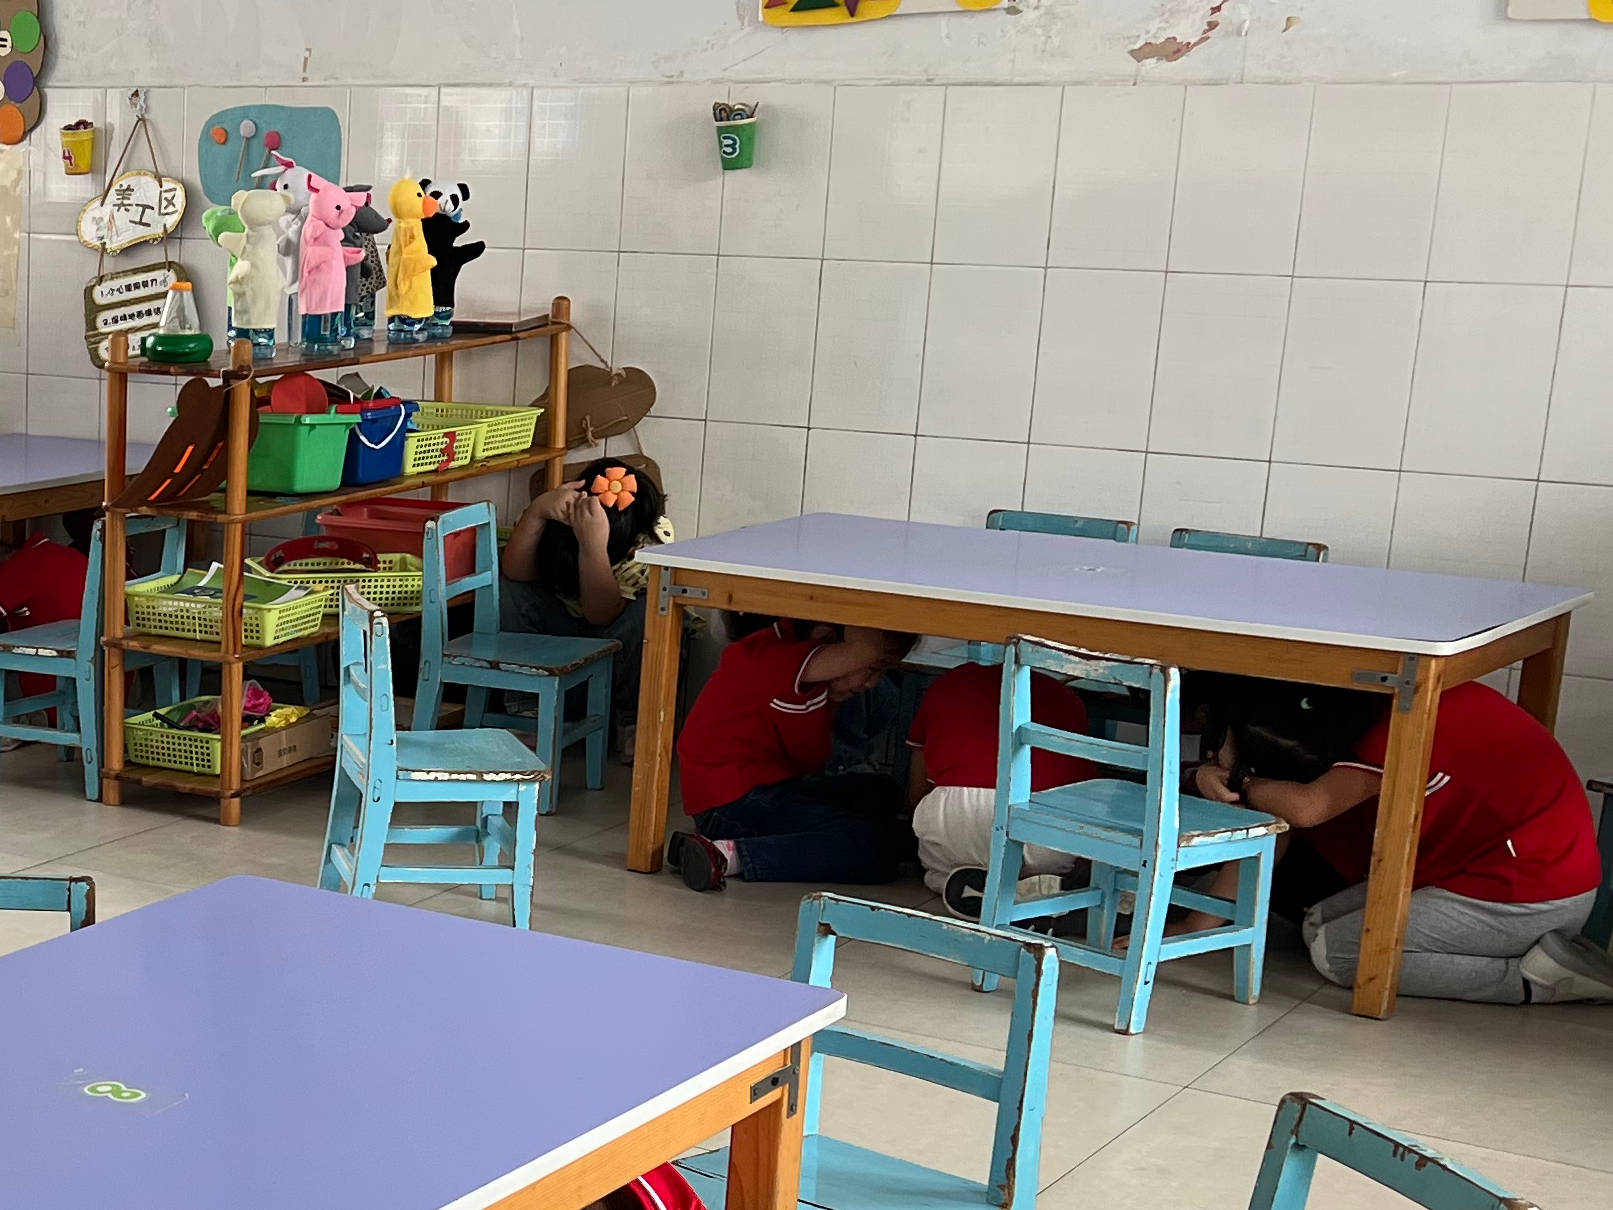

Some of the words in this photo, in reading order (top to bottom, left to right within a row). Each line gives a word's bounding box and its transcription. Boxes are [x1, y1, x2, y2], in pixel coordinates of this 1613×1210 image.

[721, 135, 739, 157] 3
[62, 148, 75, 168] 4
[112, 184, 178, 228] 美工区
[85, 1082, 145, 1101] 8
